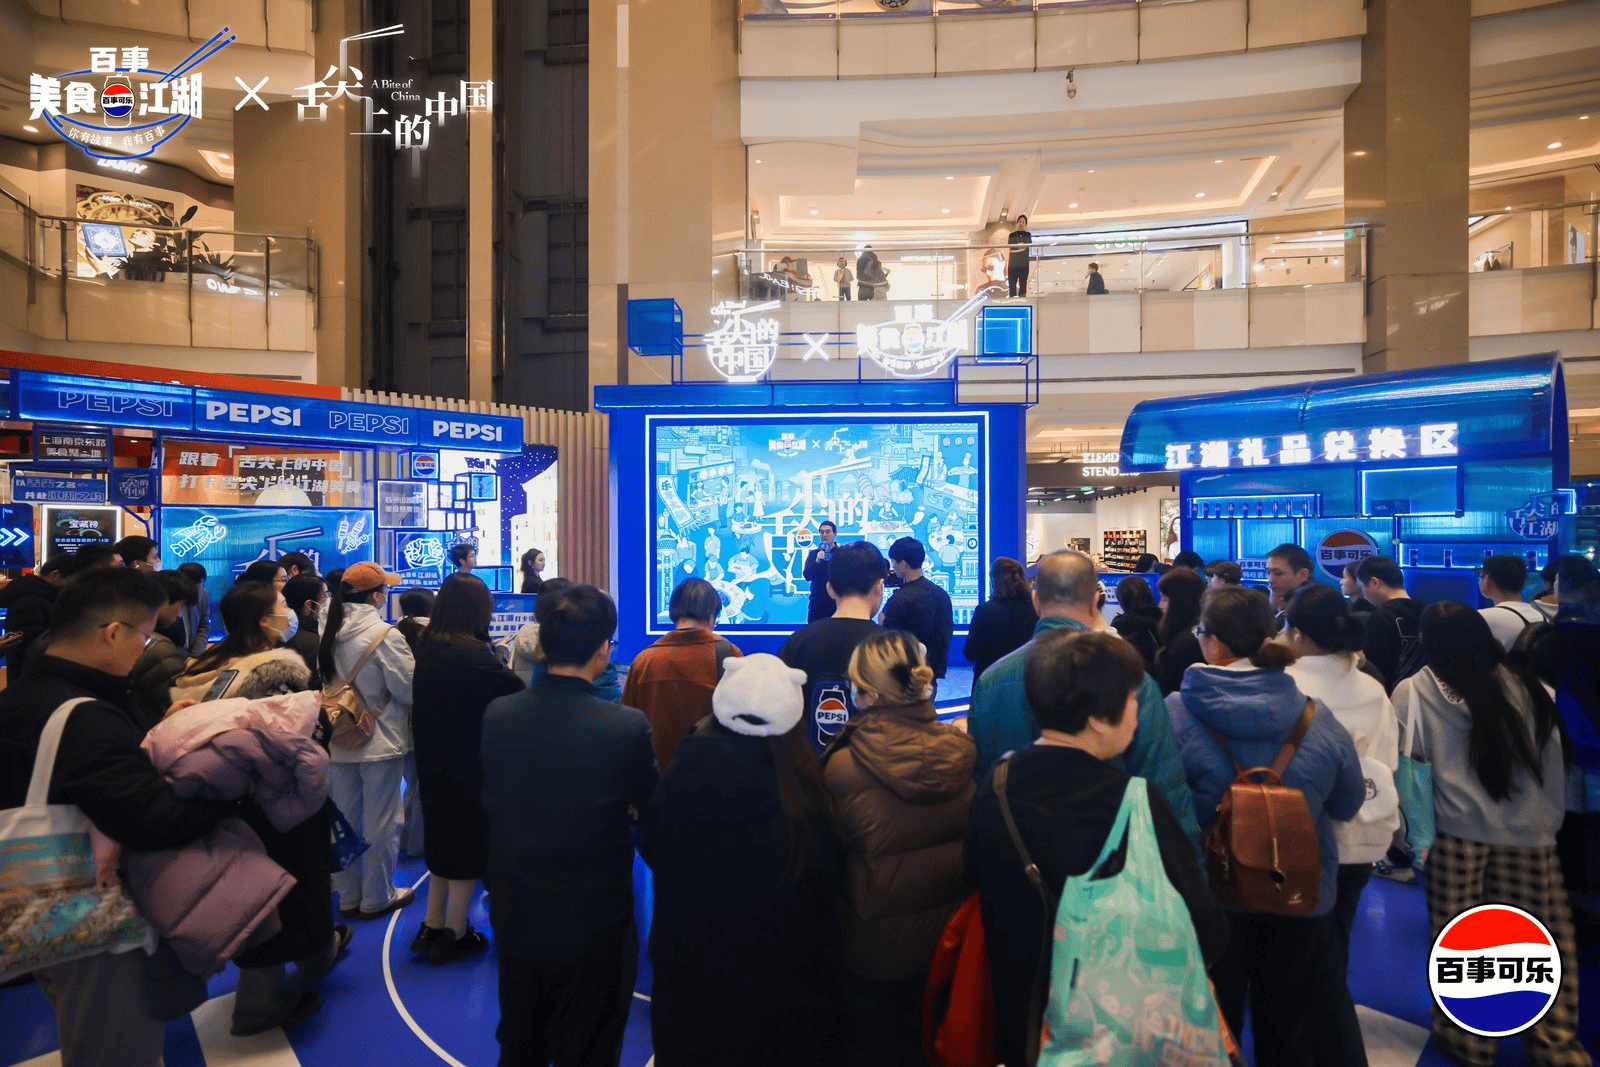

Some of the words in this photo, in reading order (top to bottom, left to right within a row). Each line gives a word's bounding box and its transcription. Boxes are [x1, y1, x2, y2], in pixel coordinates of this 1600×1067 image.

[57, 388, 173, 417] PEPSI
[206, 401, 301, 427] PEPSI
[328, 410, 409, 435] PEPSI
[40, 435, 106, 447] 上海南京东路
[432, 420, 503, 442] PEPSI
[1165, 421, 1459, 470] 江湖礼品兑换区
[1082, 466, 1140, 477] STEND
[1320, 549, 1372, 561] 百事可乐
[817, 711, 847, 722] PEPSI
